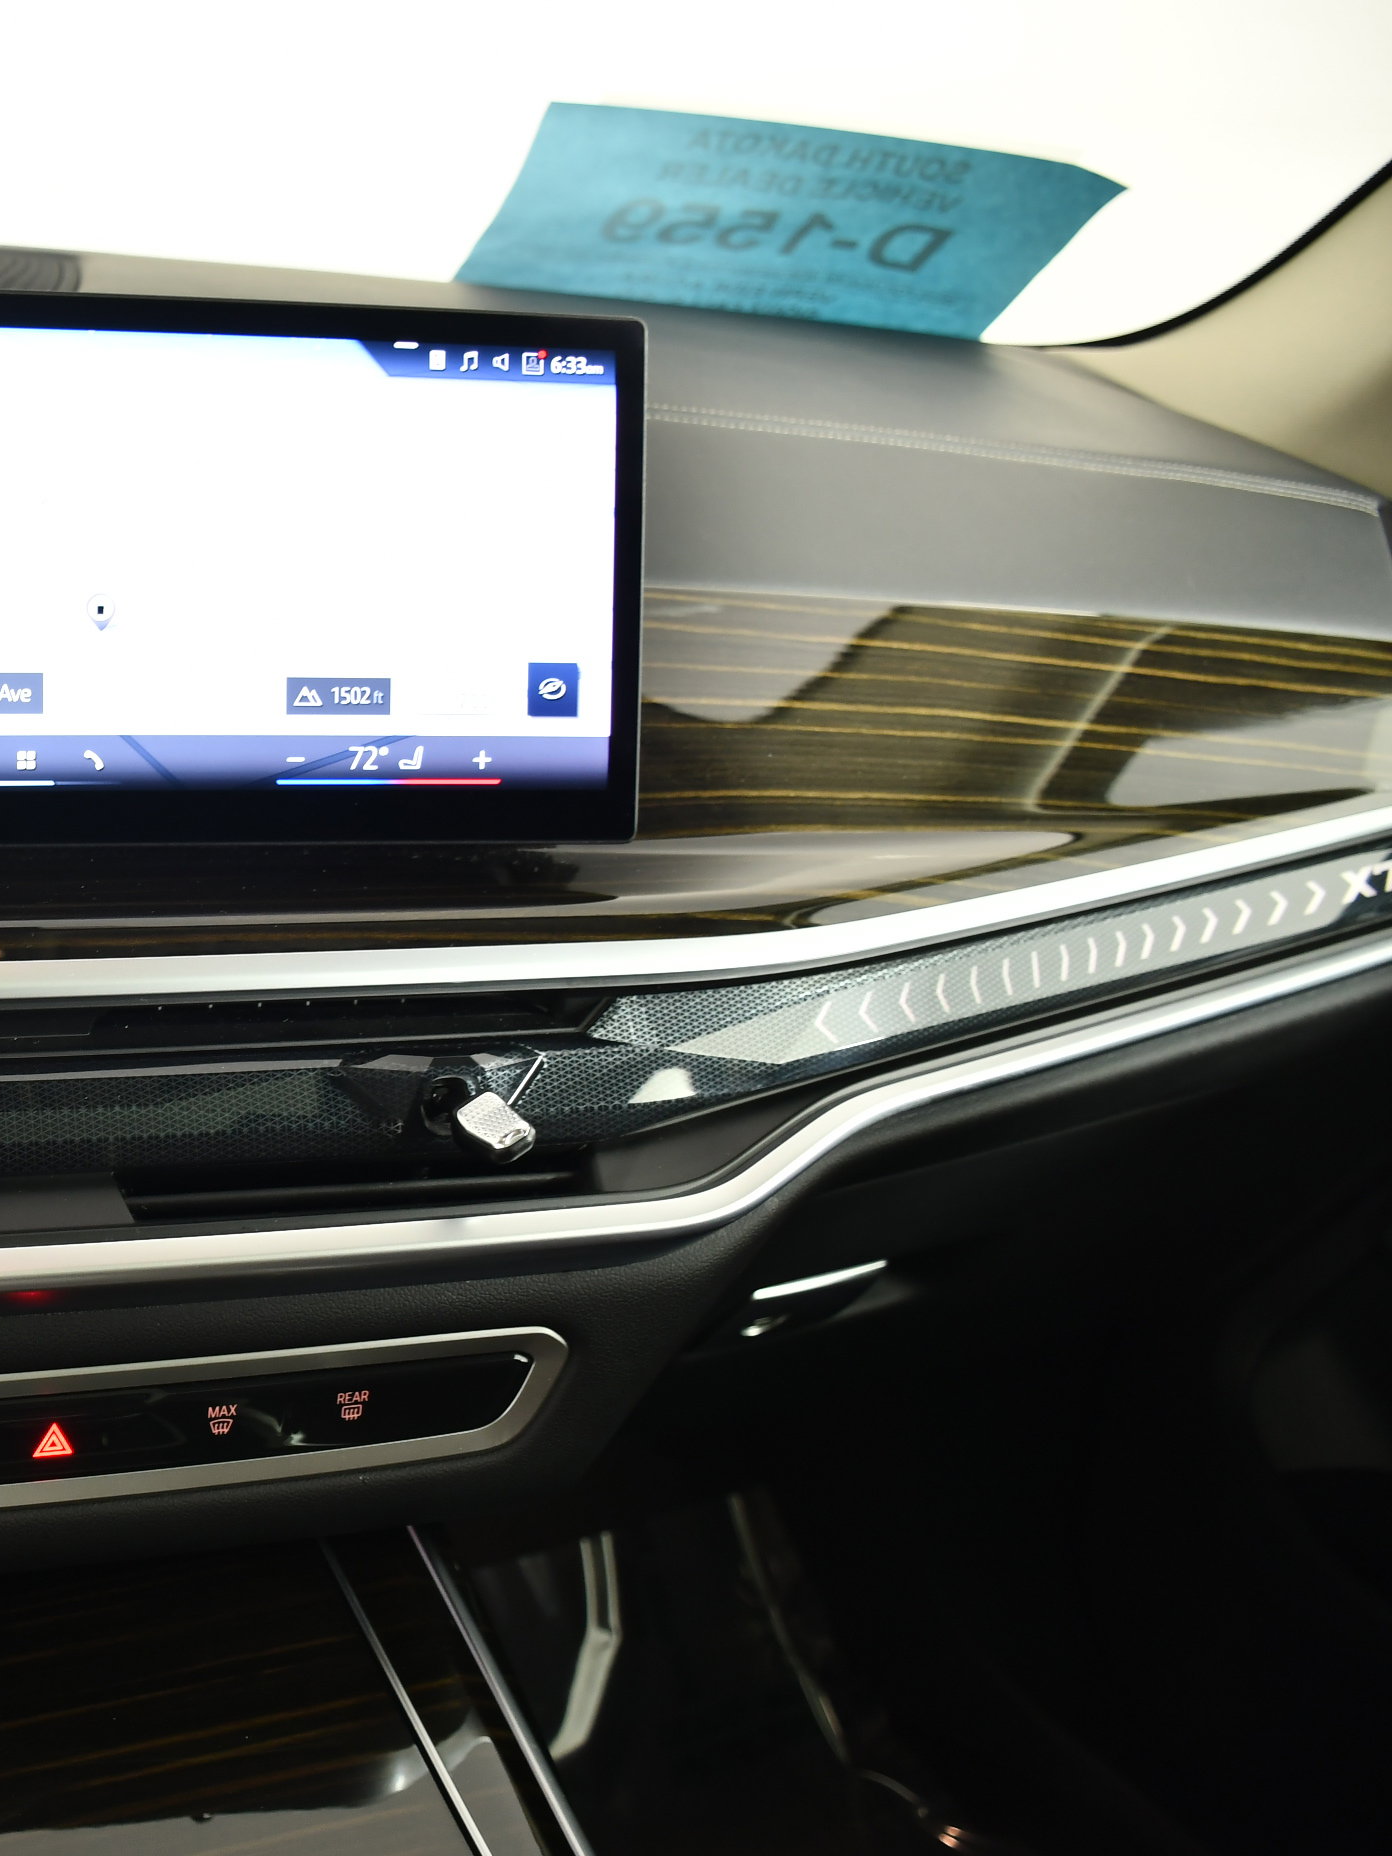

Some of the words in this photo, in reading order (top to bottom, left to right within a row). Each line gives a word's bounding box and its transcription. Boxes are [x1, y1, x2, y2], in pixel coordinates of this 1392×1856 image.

[330, 687, 371, 706] 1502
[373, 689, 384, 705] ft
[336, 1390, 370, 1405] REAR
[208, 1404, 238, 1418] MAX
